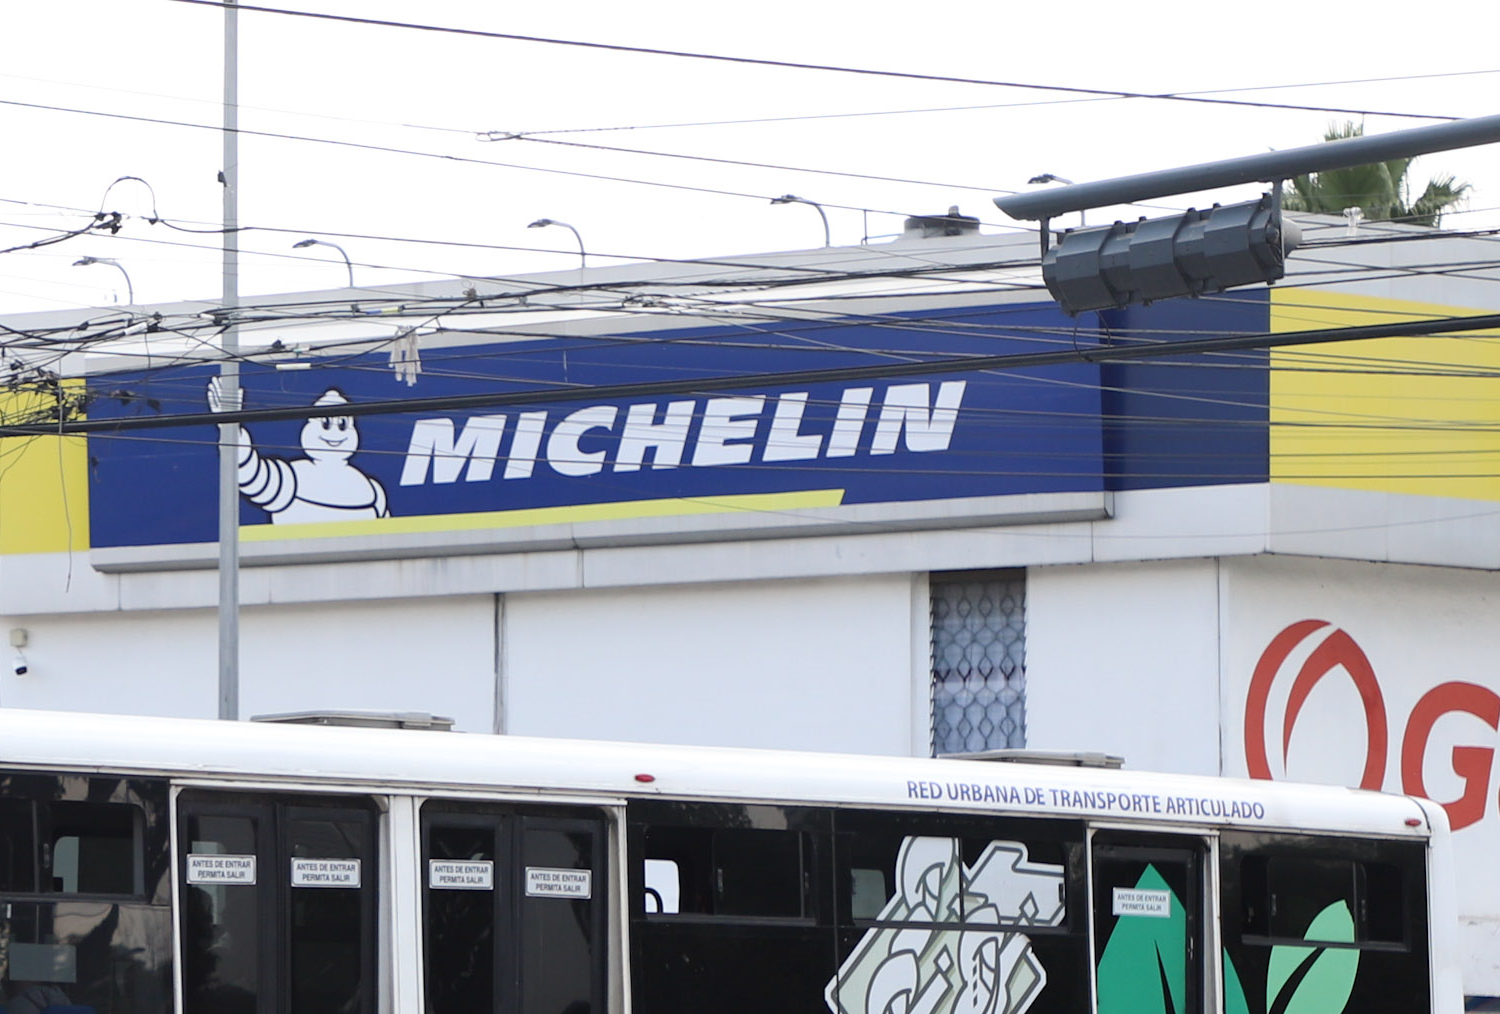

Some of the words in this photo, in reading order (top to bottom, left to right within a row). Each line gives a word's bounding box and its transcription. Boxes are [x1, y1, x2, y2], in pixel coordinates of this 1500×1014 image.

[400, 380, 966, 487] MICHELIN
[907, 780, 942, 800] RED
[946, 783, 1021, 804] URBANA
[1024, 787, 1045, 805] DE
[1049, 788, 1161, 813] TRANSPORTE
[1166, 796, 1265, 819] ARTICULADO
[192, 860, 213, 868] ANTES
[215, 860, 224, 868] DE
[225, 860, 251, 869] ENTRAR
[296, 863, 318, 871] ANTES
[320, 863, 328, 871] DE
[330, 864, 356, 872] ENTRAR
[435, 865, 454, 873] ANTES
[465, 866, 489, 874] ENTRAR
[198, 871, 225, 879] PERMITA
[226, 871, 245, 879] SALIR
[302, 873, 329, 881] PERMITA
[331, 874, 350, 882] SALIR
[531, 873, 550, 881] ANTES
[552, 874, 560, 882] DE
[561, 874, 587, 883] ENTRAR
[466, 876, 484, 884] SALIR
[536, 883, 561, 892] PERMITA
[563, 884, 582, 892] SALIR
